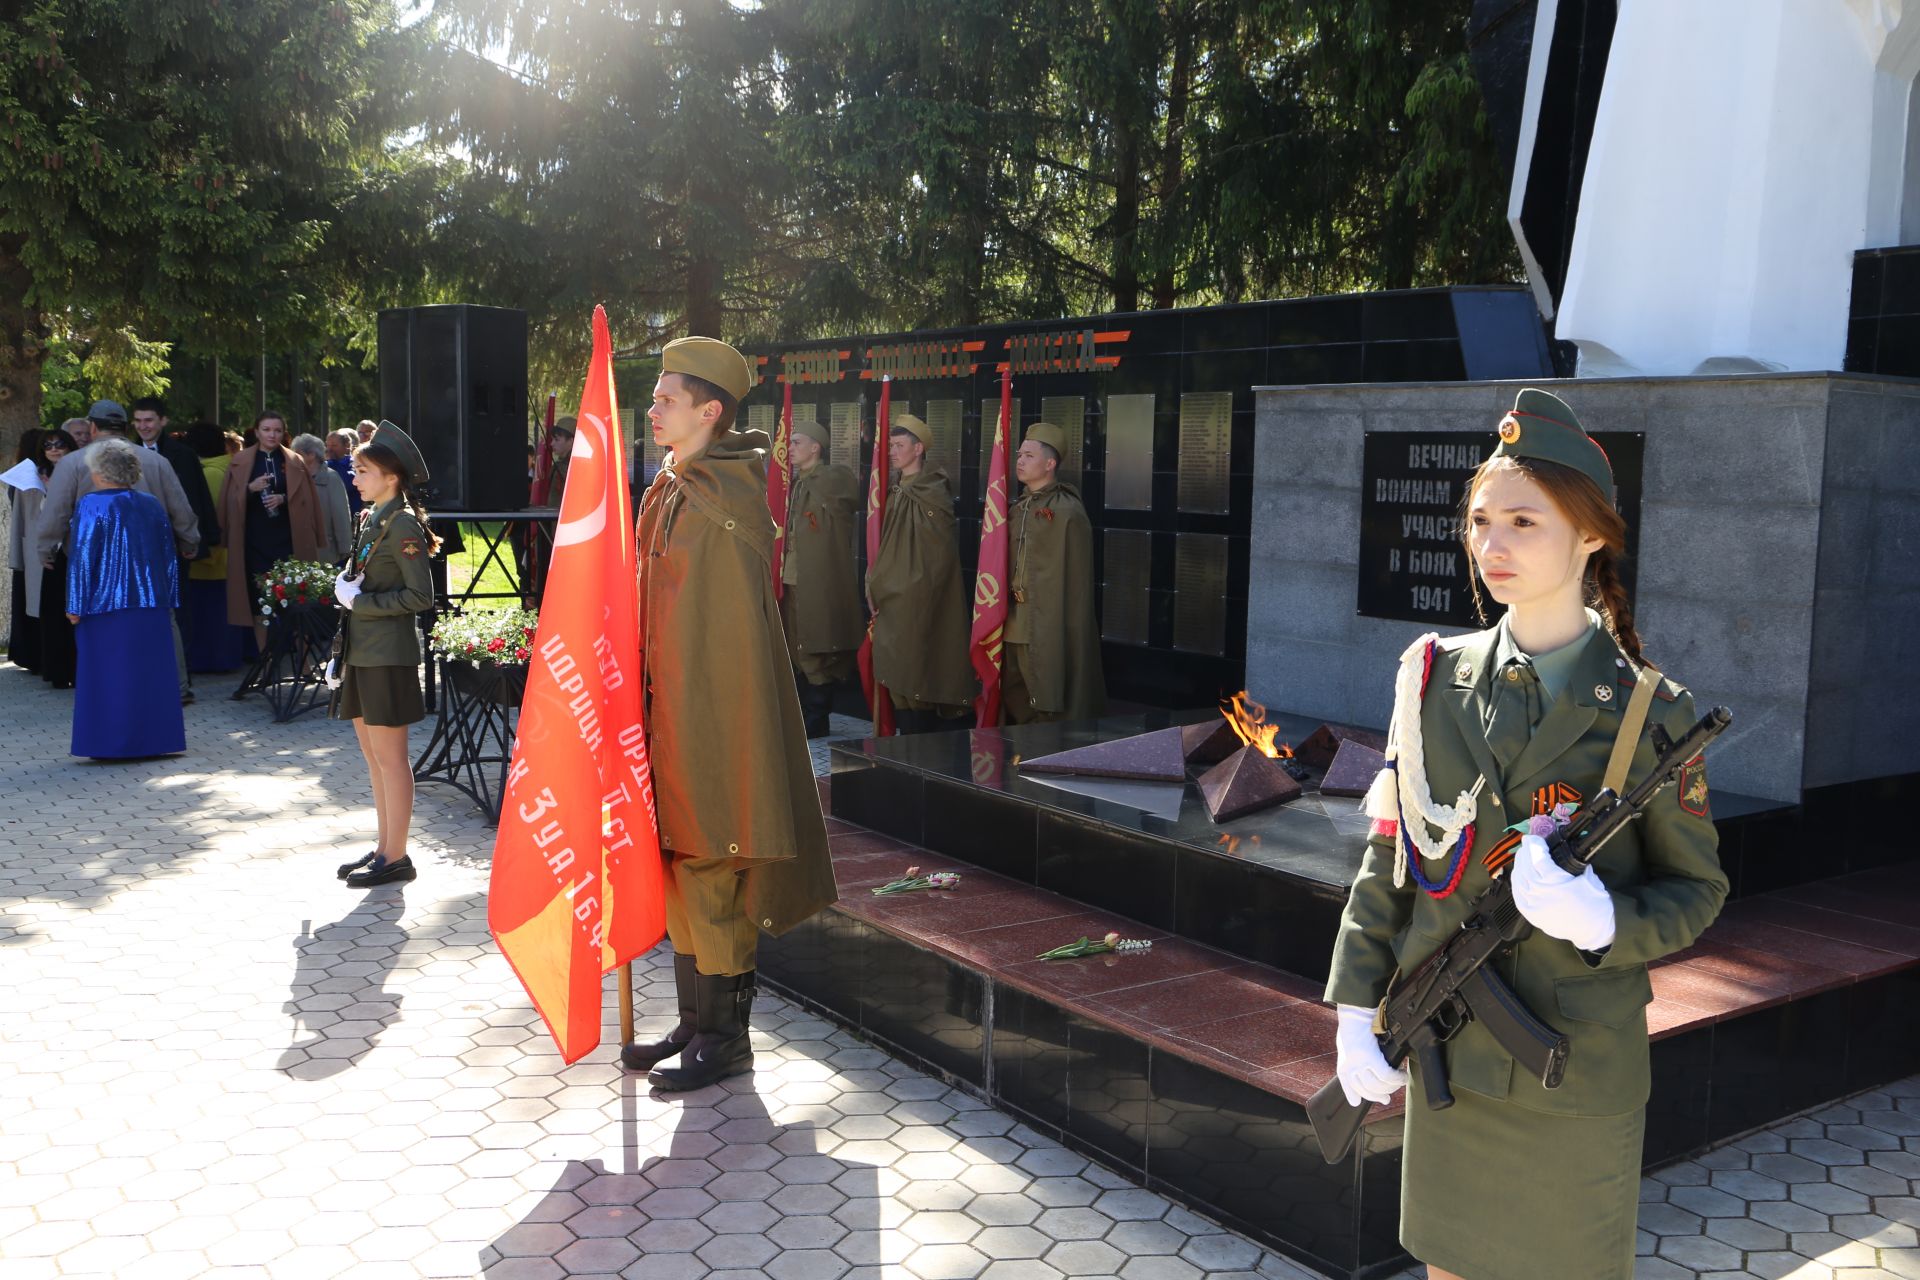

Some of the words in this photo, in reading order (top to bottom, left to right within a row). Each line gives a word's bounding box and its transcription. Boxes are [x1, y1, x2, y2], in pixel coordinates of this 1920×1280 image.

[1408, 444, 1481, 470] ВЕЧНАЯ
[1376, 478, 1451, 505] ВОИНАМ
[1389, 548, 1401, 572] В
[1409, 550, 1457, 577] БОЯХ
[1410, 585, 1451, 612] 1941
[519, 786, 558, 824] 3
